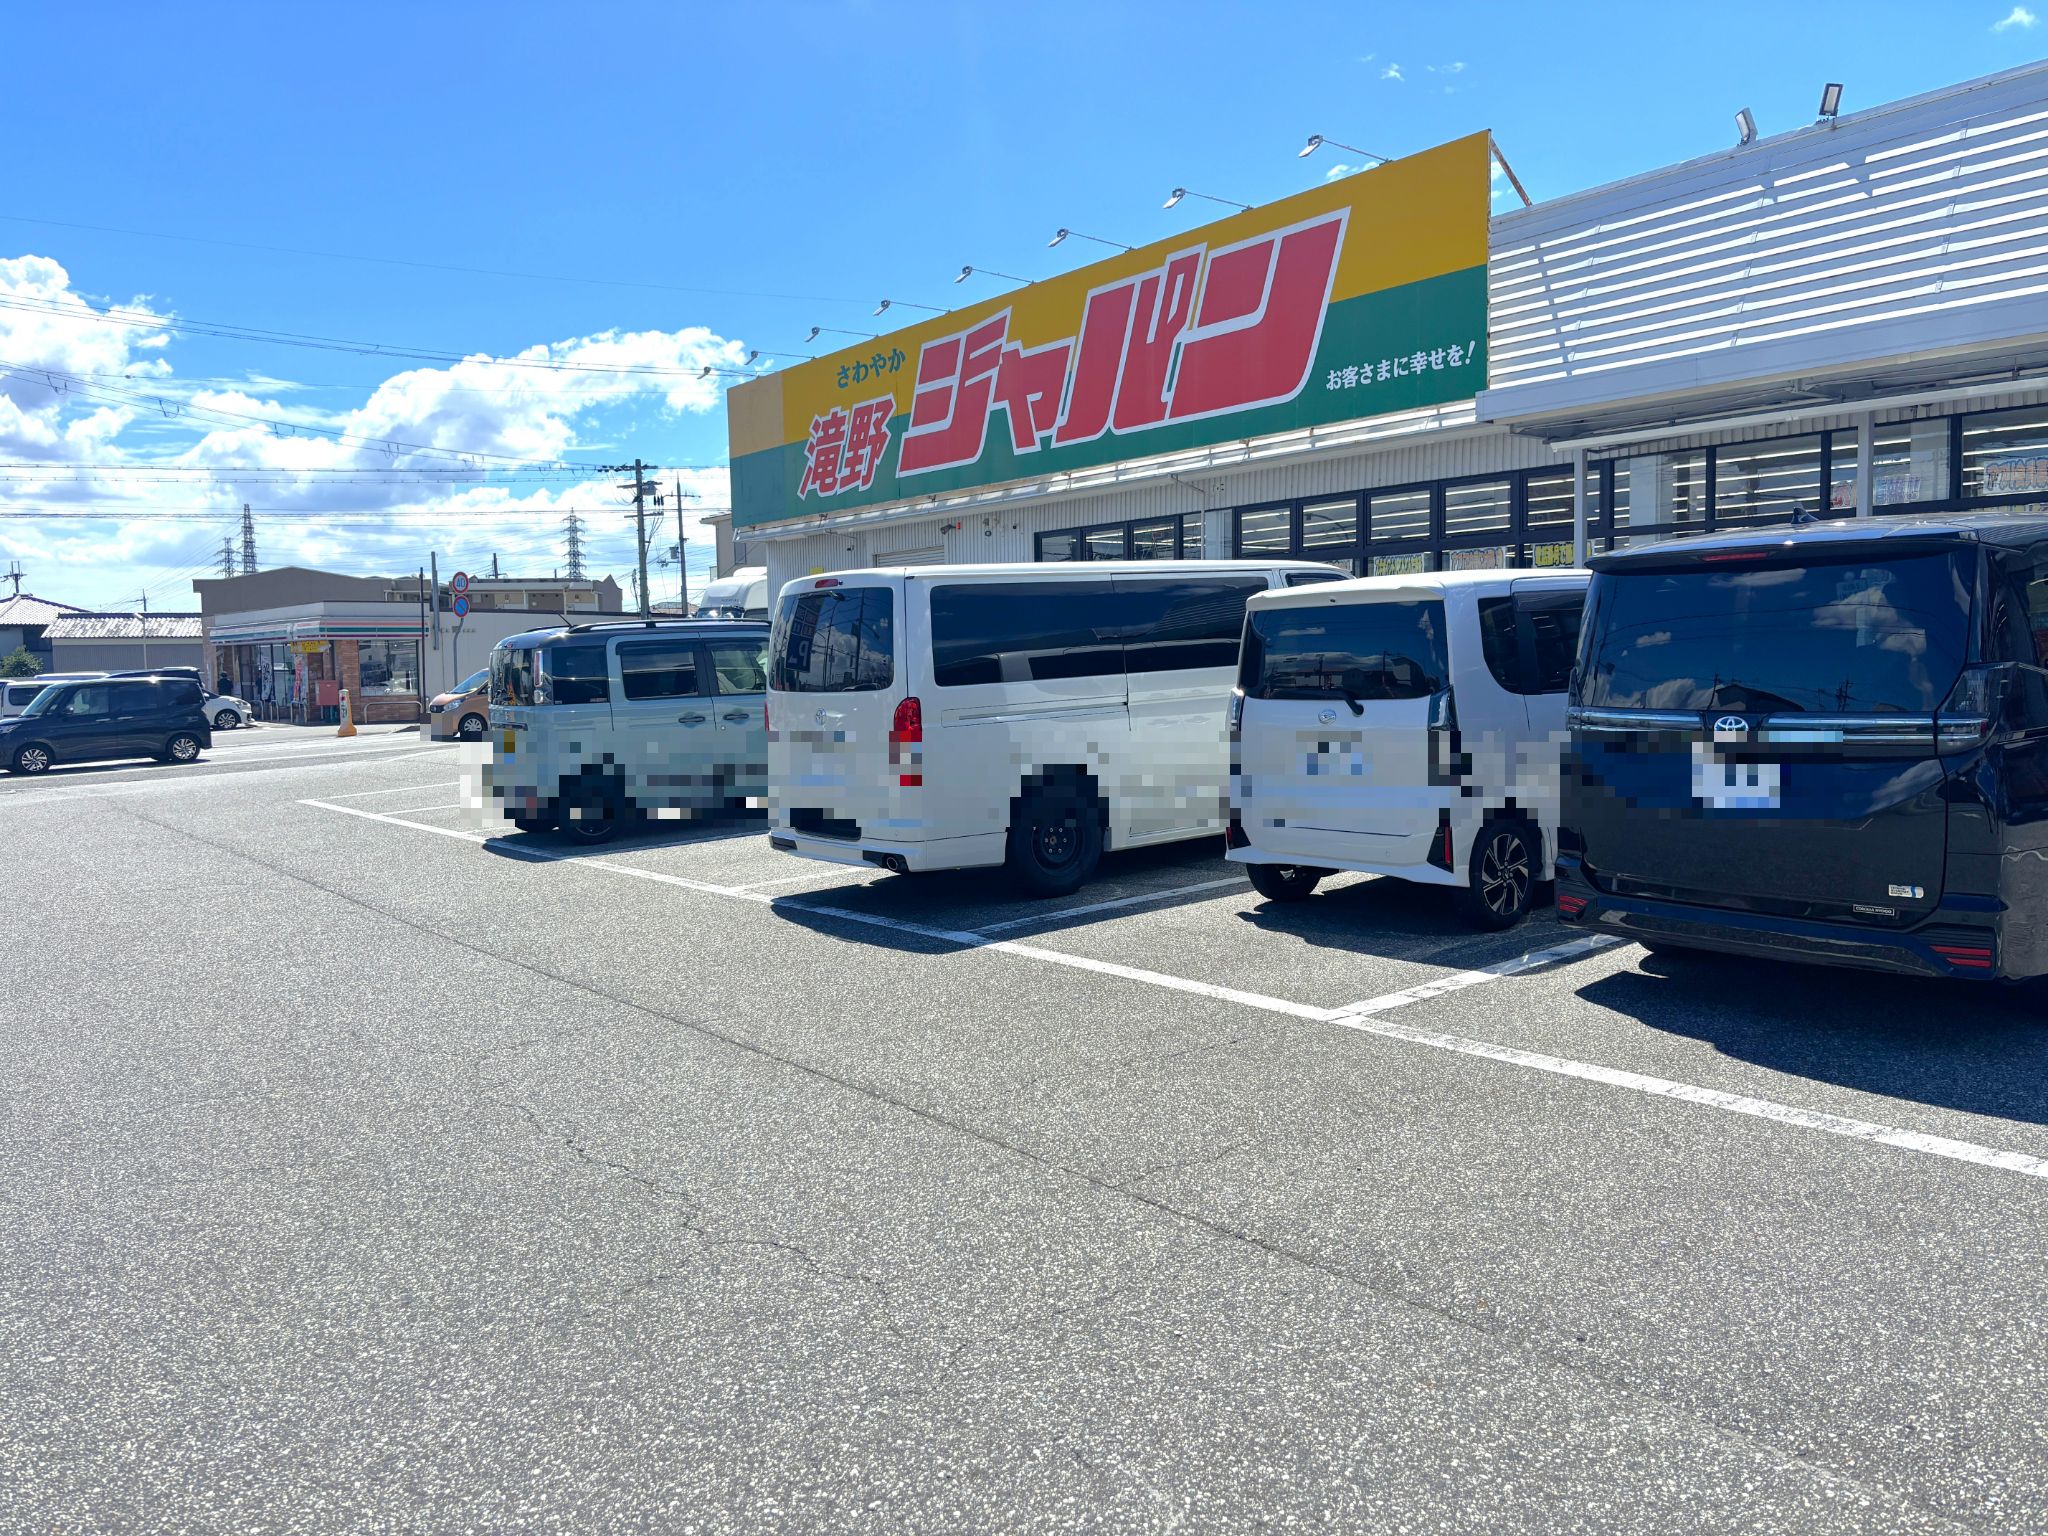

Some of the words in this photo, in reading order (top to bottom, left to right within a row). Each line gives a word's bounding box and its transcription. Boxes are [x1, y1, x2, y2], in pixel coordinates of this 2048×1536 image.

[836, 348, 906, 388] さわやか
[896, 206, 1351, 478] ジャパン
[797, 392, 897, 501] 滝野
